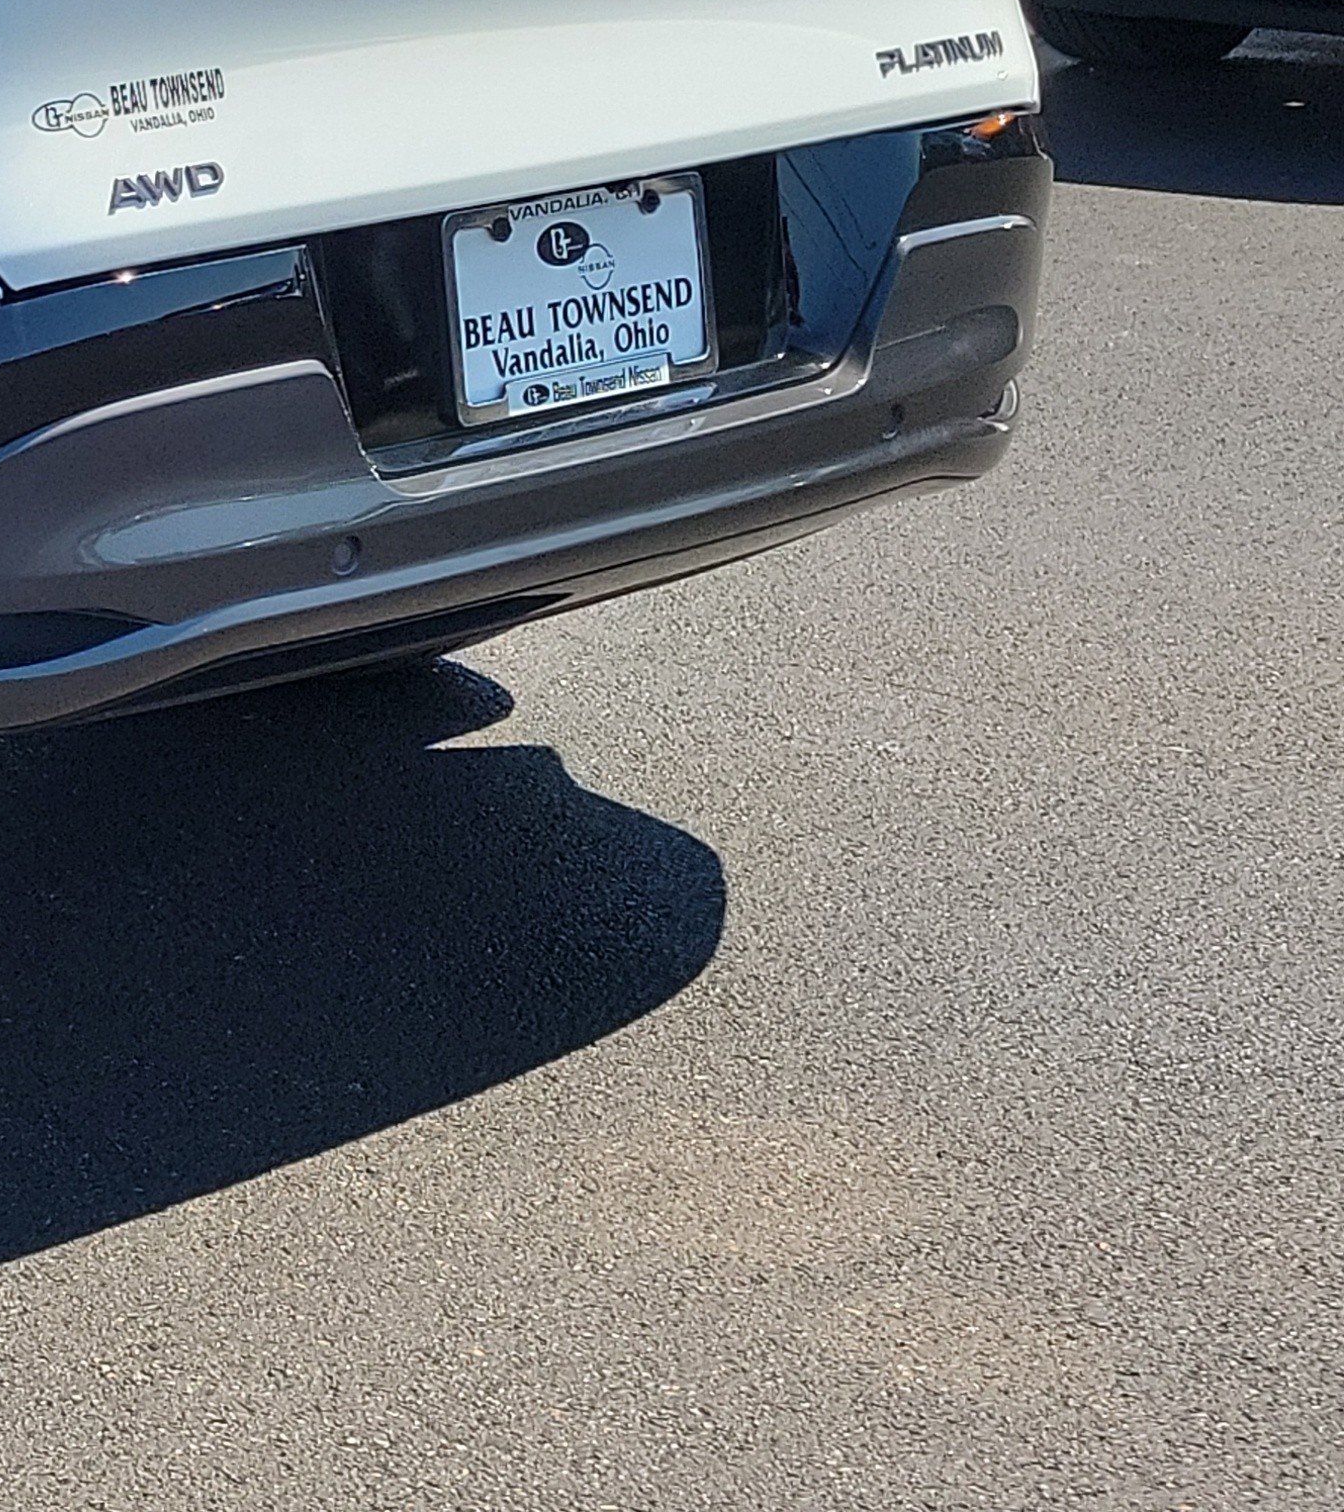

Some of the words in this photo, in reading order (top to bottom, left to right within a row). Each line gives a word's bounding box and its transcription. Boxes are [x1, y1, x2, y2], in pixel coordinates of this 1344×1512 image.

[876, 30, 1004, 79] PLATINUM
[64, 107, 110, 125] NISSAN
[110, 81, 148, 117] BEAU
[149, 68, 226, 108] TOWNSEND
[130, 112, 188, 134] VANDALIA,
[189, 105, 215, 123] OHIO
[108, 161, 225, 215] AWD
[578, 258, 616, 274] NISSAN
[464, 306, 536, 350] BEAU
[548, 276, 693, 333] TOWNSEND
[492, 333, 605, 378] Vandalia,
[613, 317, 671, 354] Ohio
